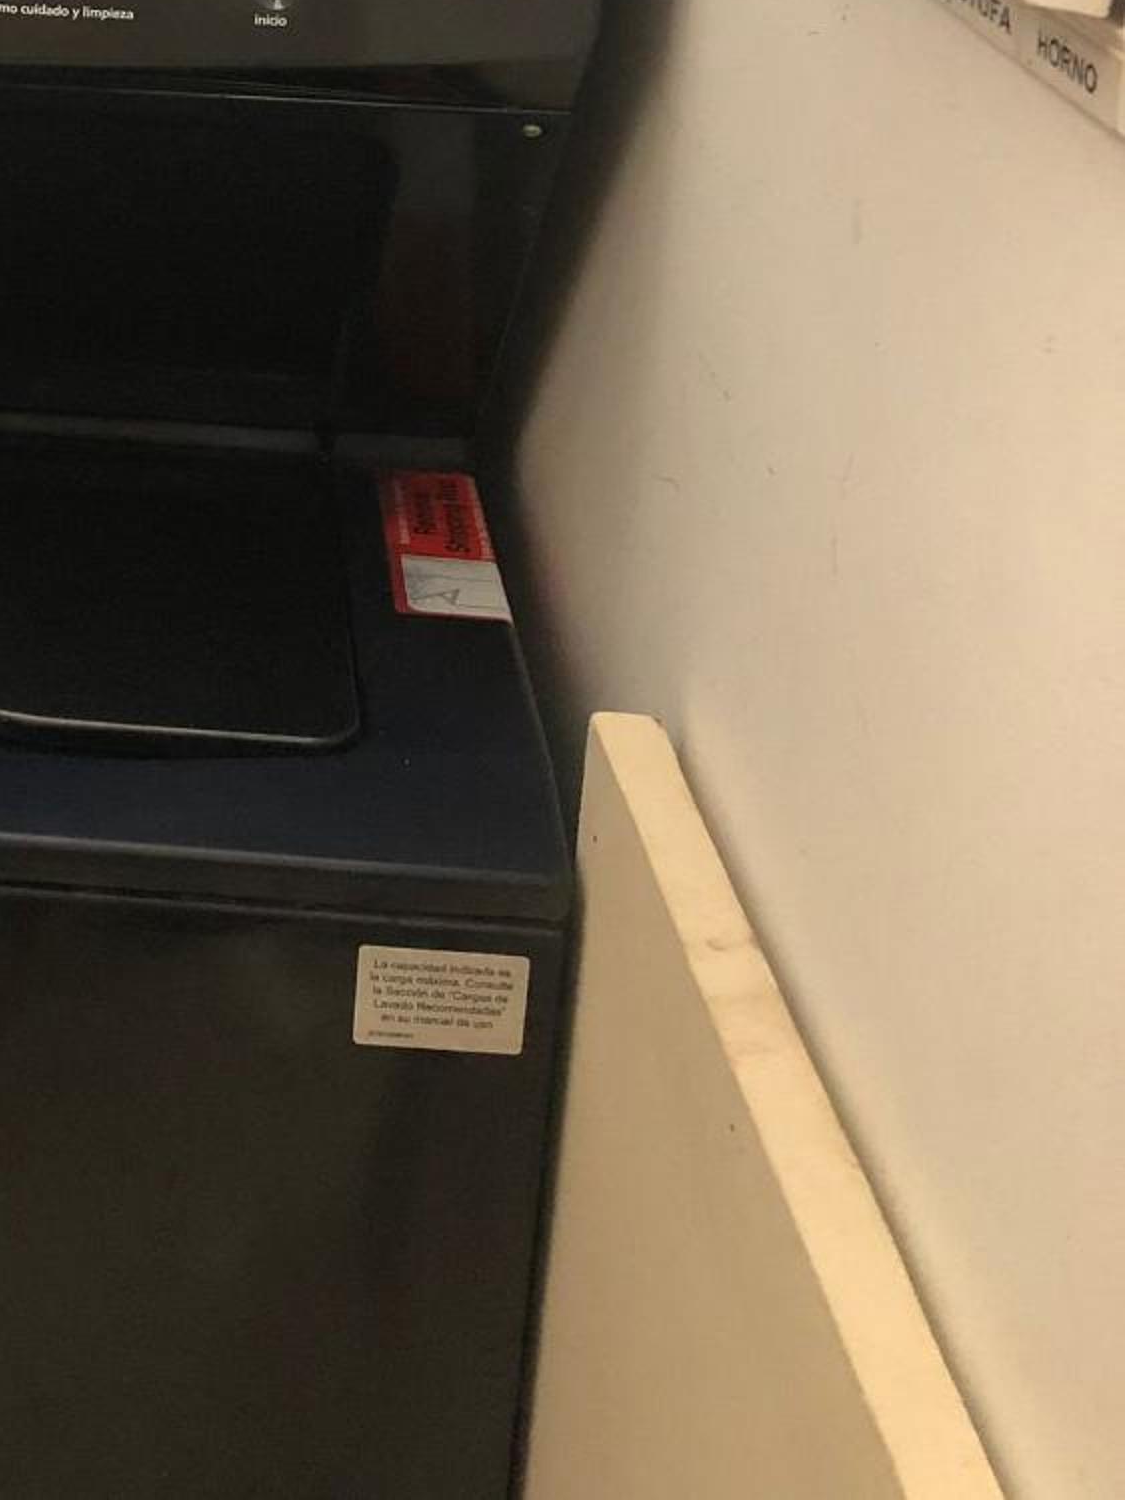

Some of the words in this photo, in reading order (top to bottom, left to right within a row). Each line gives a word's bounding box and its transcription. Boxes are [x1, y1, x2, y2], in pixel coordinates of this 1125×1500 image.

[20, 2, 70, 17] cuidado
[72, 7, 81, 20] y
[82, 4, 135, 21] limpieza
[253, 12, 288, 28] inicio
[1036, 28, 1099, 95] HORNO
[373, 960, 388, 969] La
[390, 961, 448, 974] capacidad
[449, 964, 495, 977] indicada
[369, 971, 380, 981] la
[382, 975, 413, 986] carga
[372, 985, 382, 995] la
[430, 988, 446, 999] de
[494, 994, 509, 1004] de
[413, 1015, 453, 1026] manual
[456, 1018, 470, 1027] de
